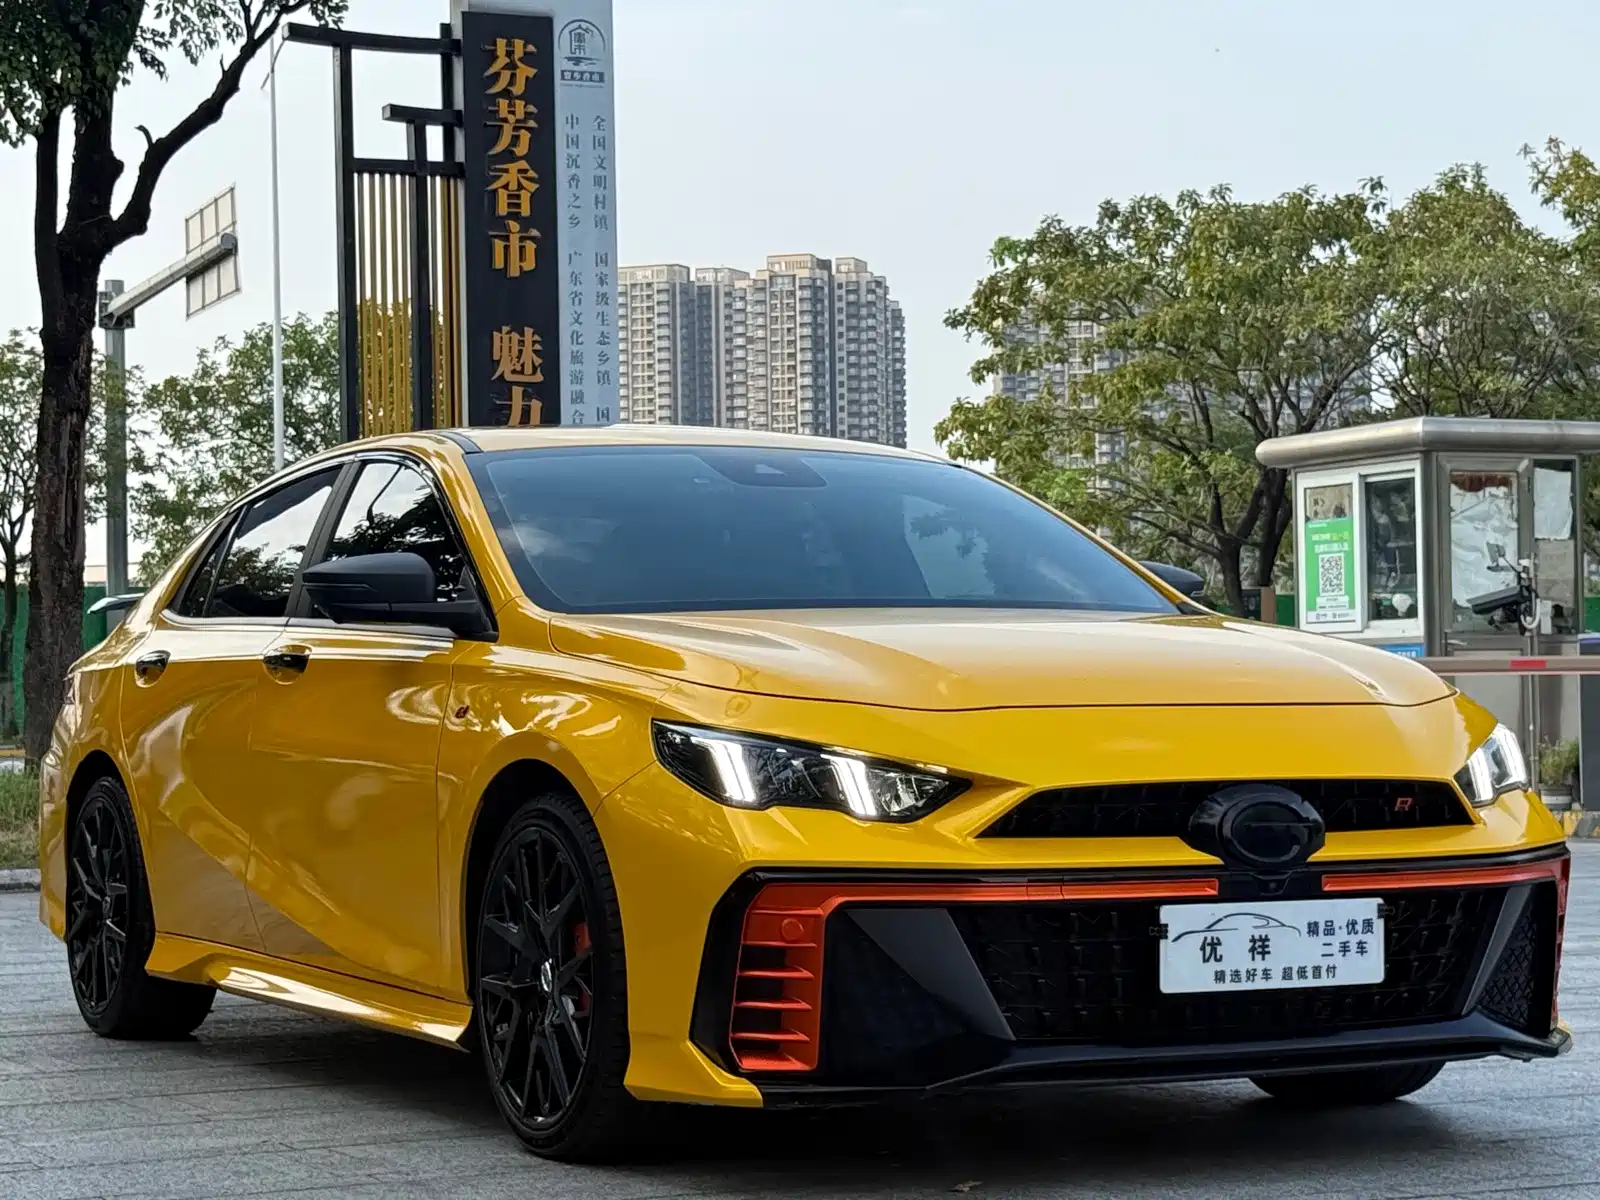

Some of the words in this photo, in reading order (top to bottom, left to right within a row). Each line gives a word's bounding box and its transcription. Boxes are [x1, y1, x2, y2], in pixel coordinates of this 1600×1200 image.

[482, 37, 541, 278] 芬芳香市
[565, 113, 581, 229] 中国沉香之乡
[592, 115, 609, 231] 全国文明村镇
[567, 251, 585, 425] 广东省文化旅游融合
[594, 251, 611, 387] 国家级生态乡镇
[490, 325, 544, 426] 魅力
[596, 406, 610, 422] 国
[1394, 798, 1412, 811] R
[1213, 966, 1274, 985] 精选好车
[1281, 964, 1338, 982] 超低首付
[1321, 939, 1369, 958] 二手车
